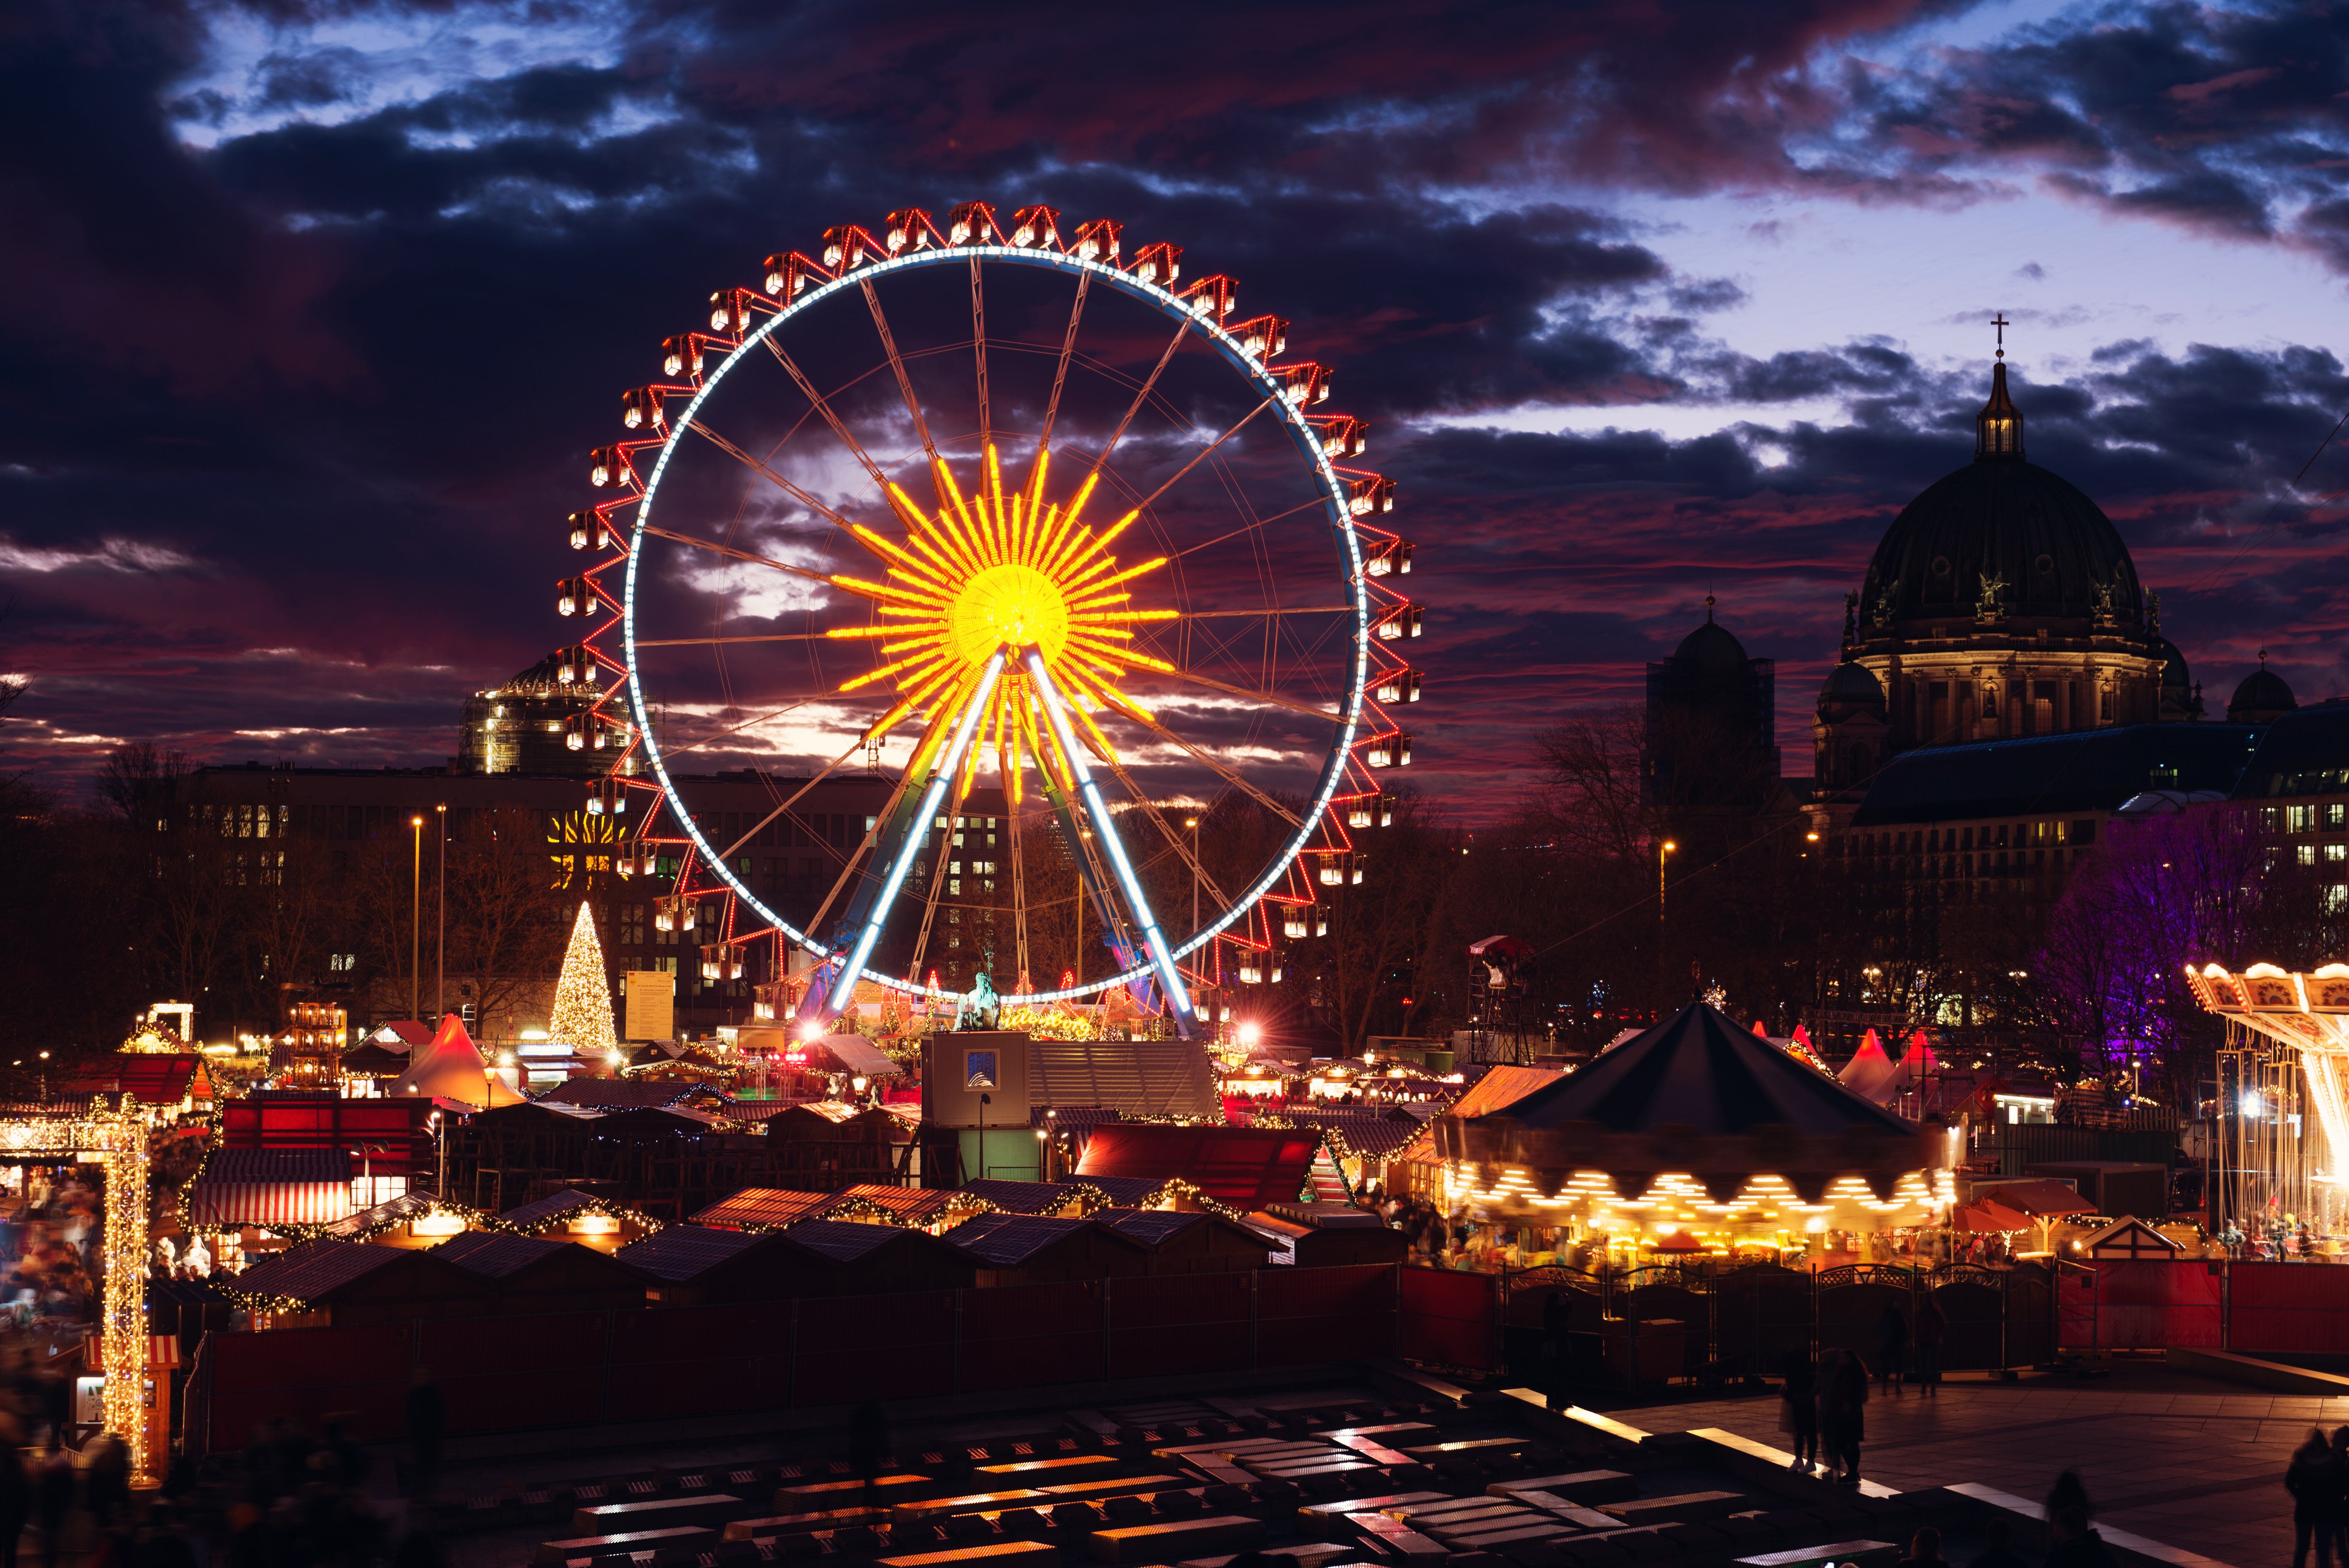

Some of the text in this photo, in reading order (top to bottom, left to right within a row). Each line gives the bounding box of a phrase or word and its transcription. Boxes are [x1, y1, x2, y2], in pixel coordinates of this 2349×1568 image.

[1001, 1006, 1090, 1037] illenborg
[250, 1228, 260, 1236] Foto
[242, 1240, 289, 1248] TOILETTEN
